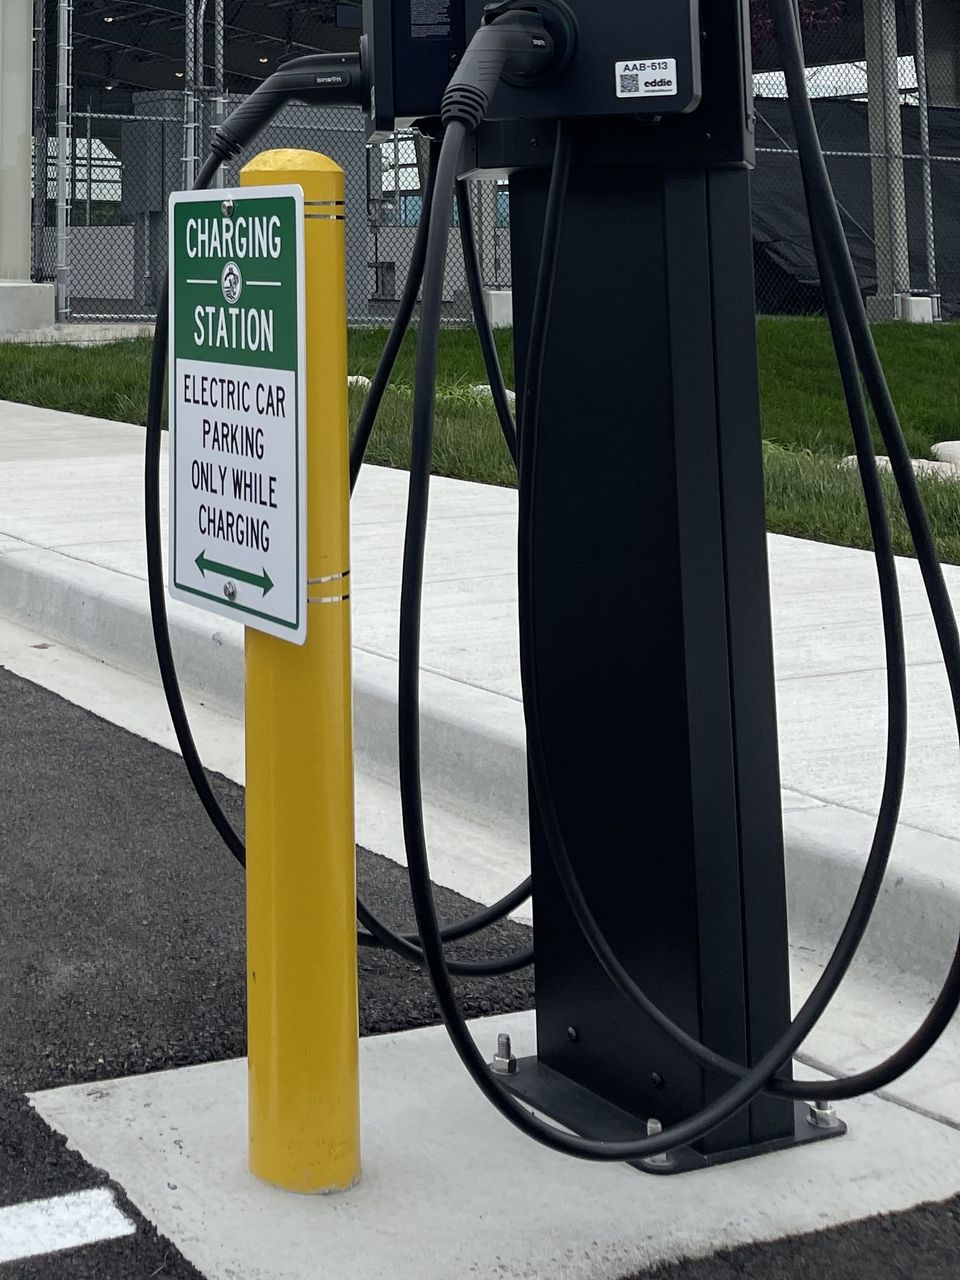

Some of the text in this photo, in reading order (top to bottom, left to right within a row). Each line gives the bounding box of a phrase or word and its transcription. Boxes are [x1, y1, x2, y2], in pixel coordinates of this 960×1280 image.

[623, 61, 668, 72] AAB-513
[643, 78, 673, 88] eddie
[186, 215, 281, 259] CHARGING
[193, 305, 274, 352] STATION
[183, 373, 286, 418] ELECTRIC CAR
[202, 418, 265, 460] PARKING
[191, 458, 278, 509] ONLY WHILE
[198, 503, 270, 554] CHARGING
